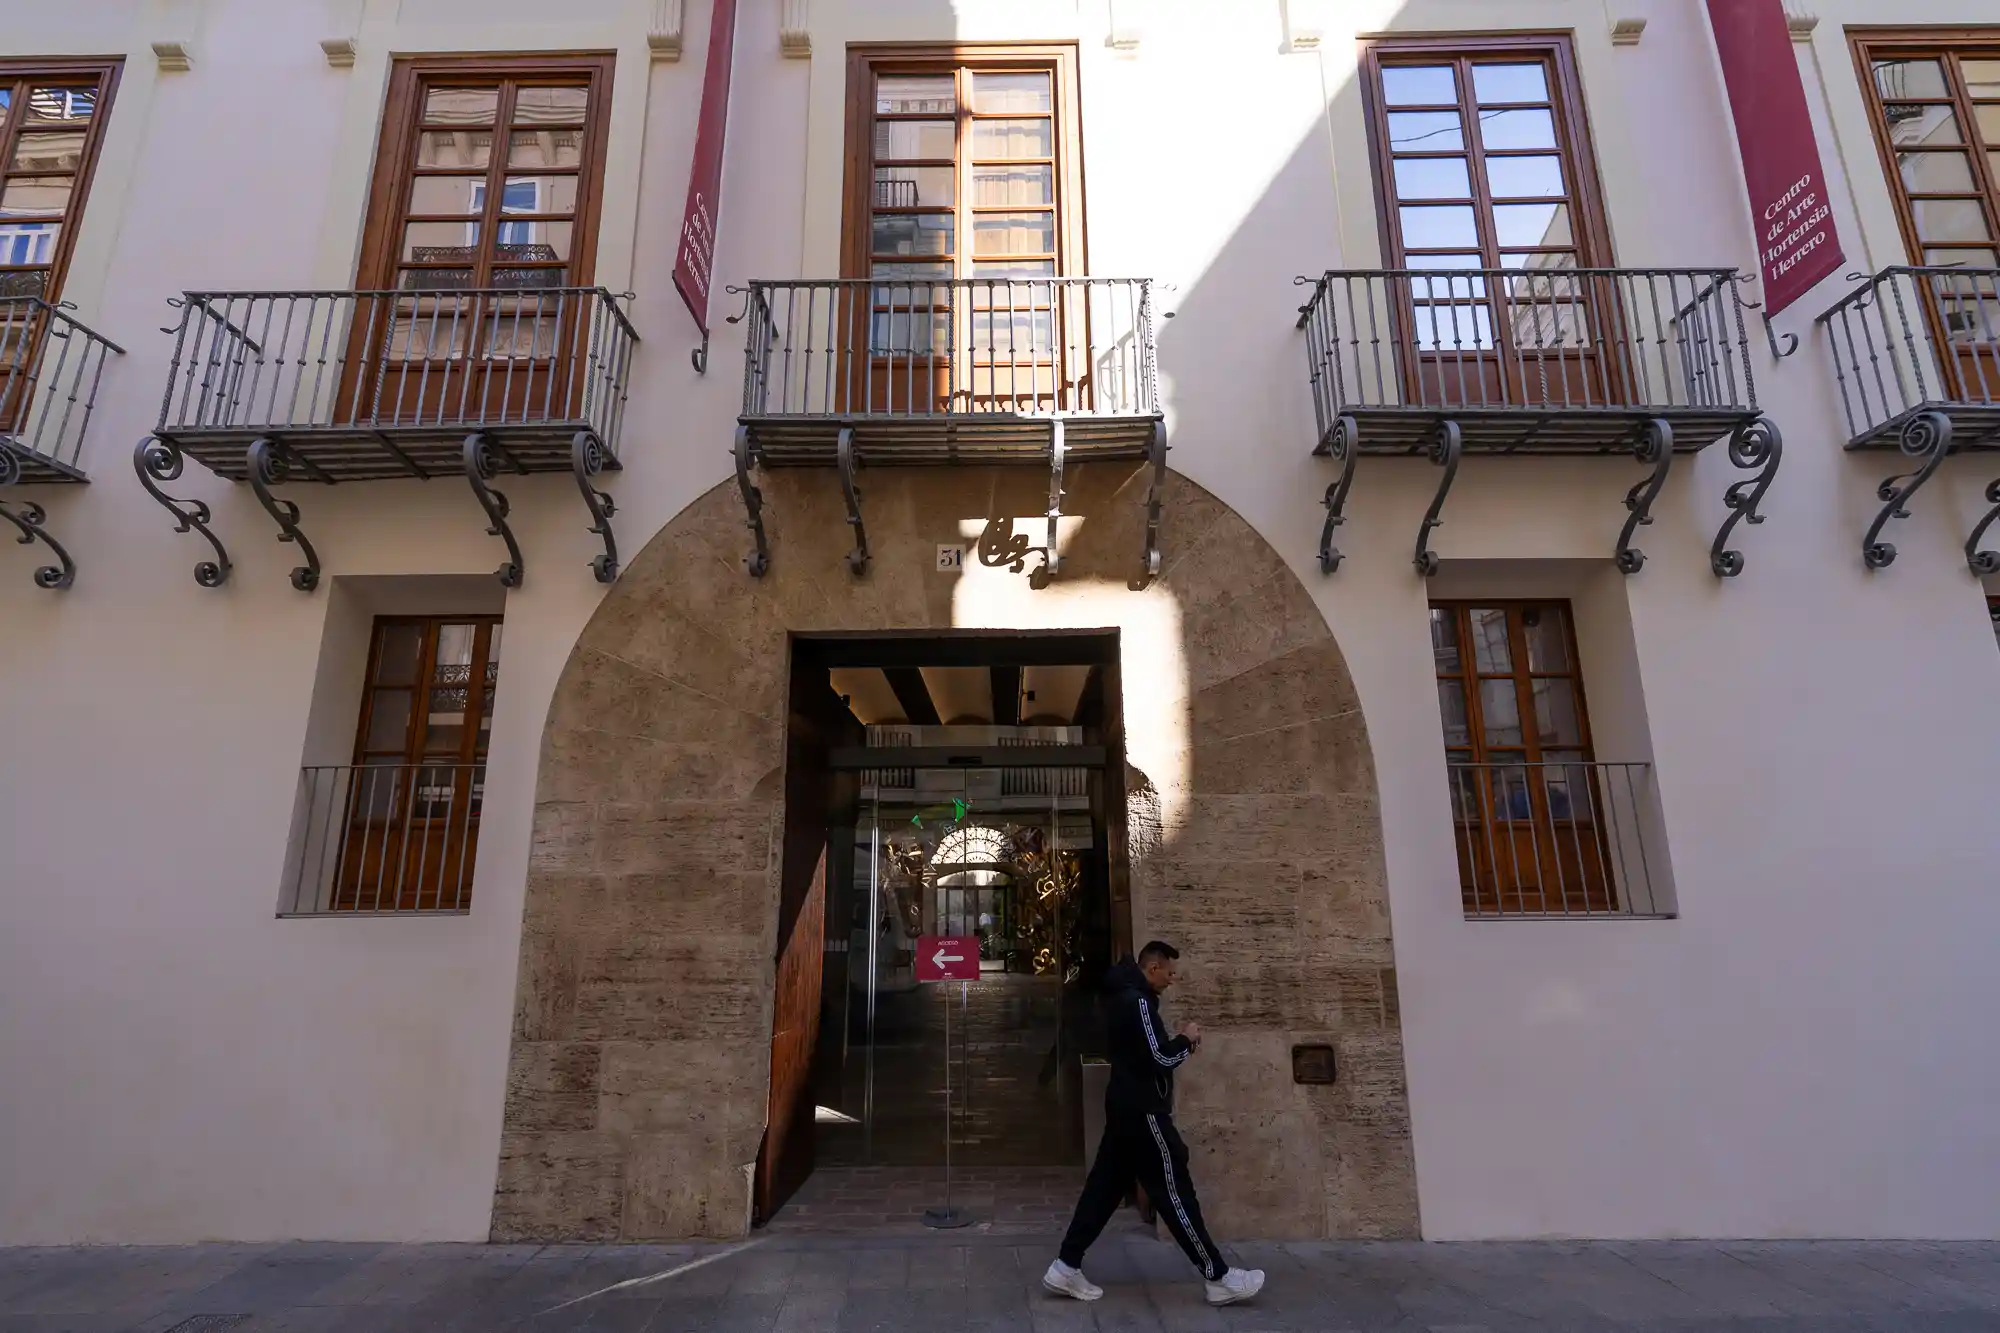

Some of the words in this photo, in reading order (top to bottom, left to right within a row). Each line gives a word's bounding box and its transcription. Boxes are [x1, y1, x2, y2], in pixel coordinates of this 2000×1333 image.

[696, 192, 712, 239] Cen
[1764, 174, 1810, 220] Centro
[1767, 221, 1784, 241] de
[1786, 192, 1815, 226] Arte
[692, 213, 702, 233] de
[1762, 205, 1829, 266] Hortensia
[683, 220, 709, 284] Horten
[1772, 231, 1826, 280] Herrero
[940, 549, 961, 567] 31
